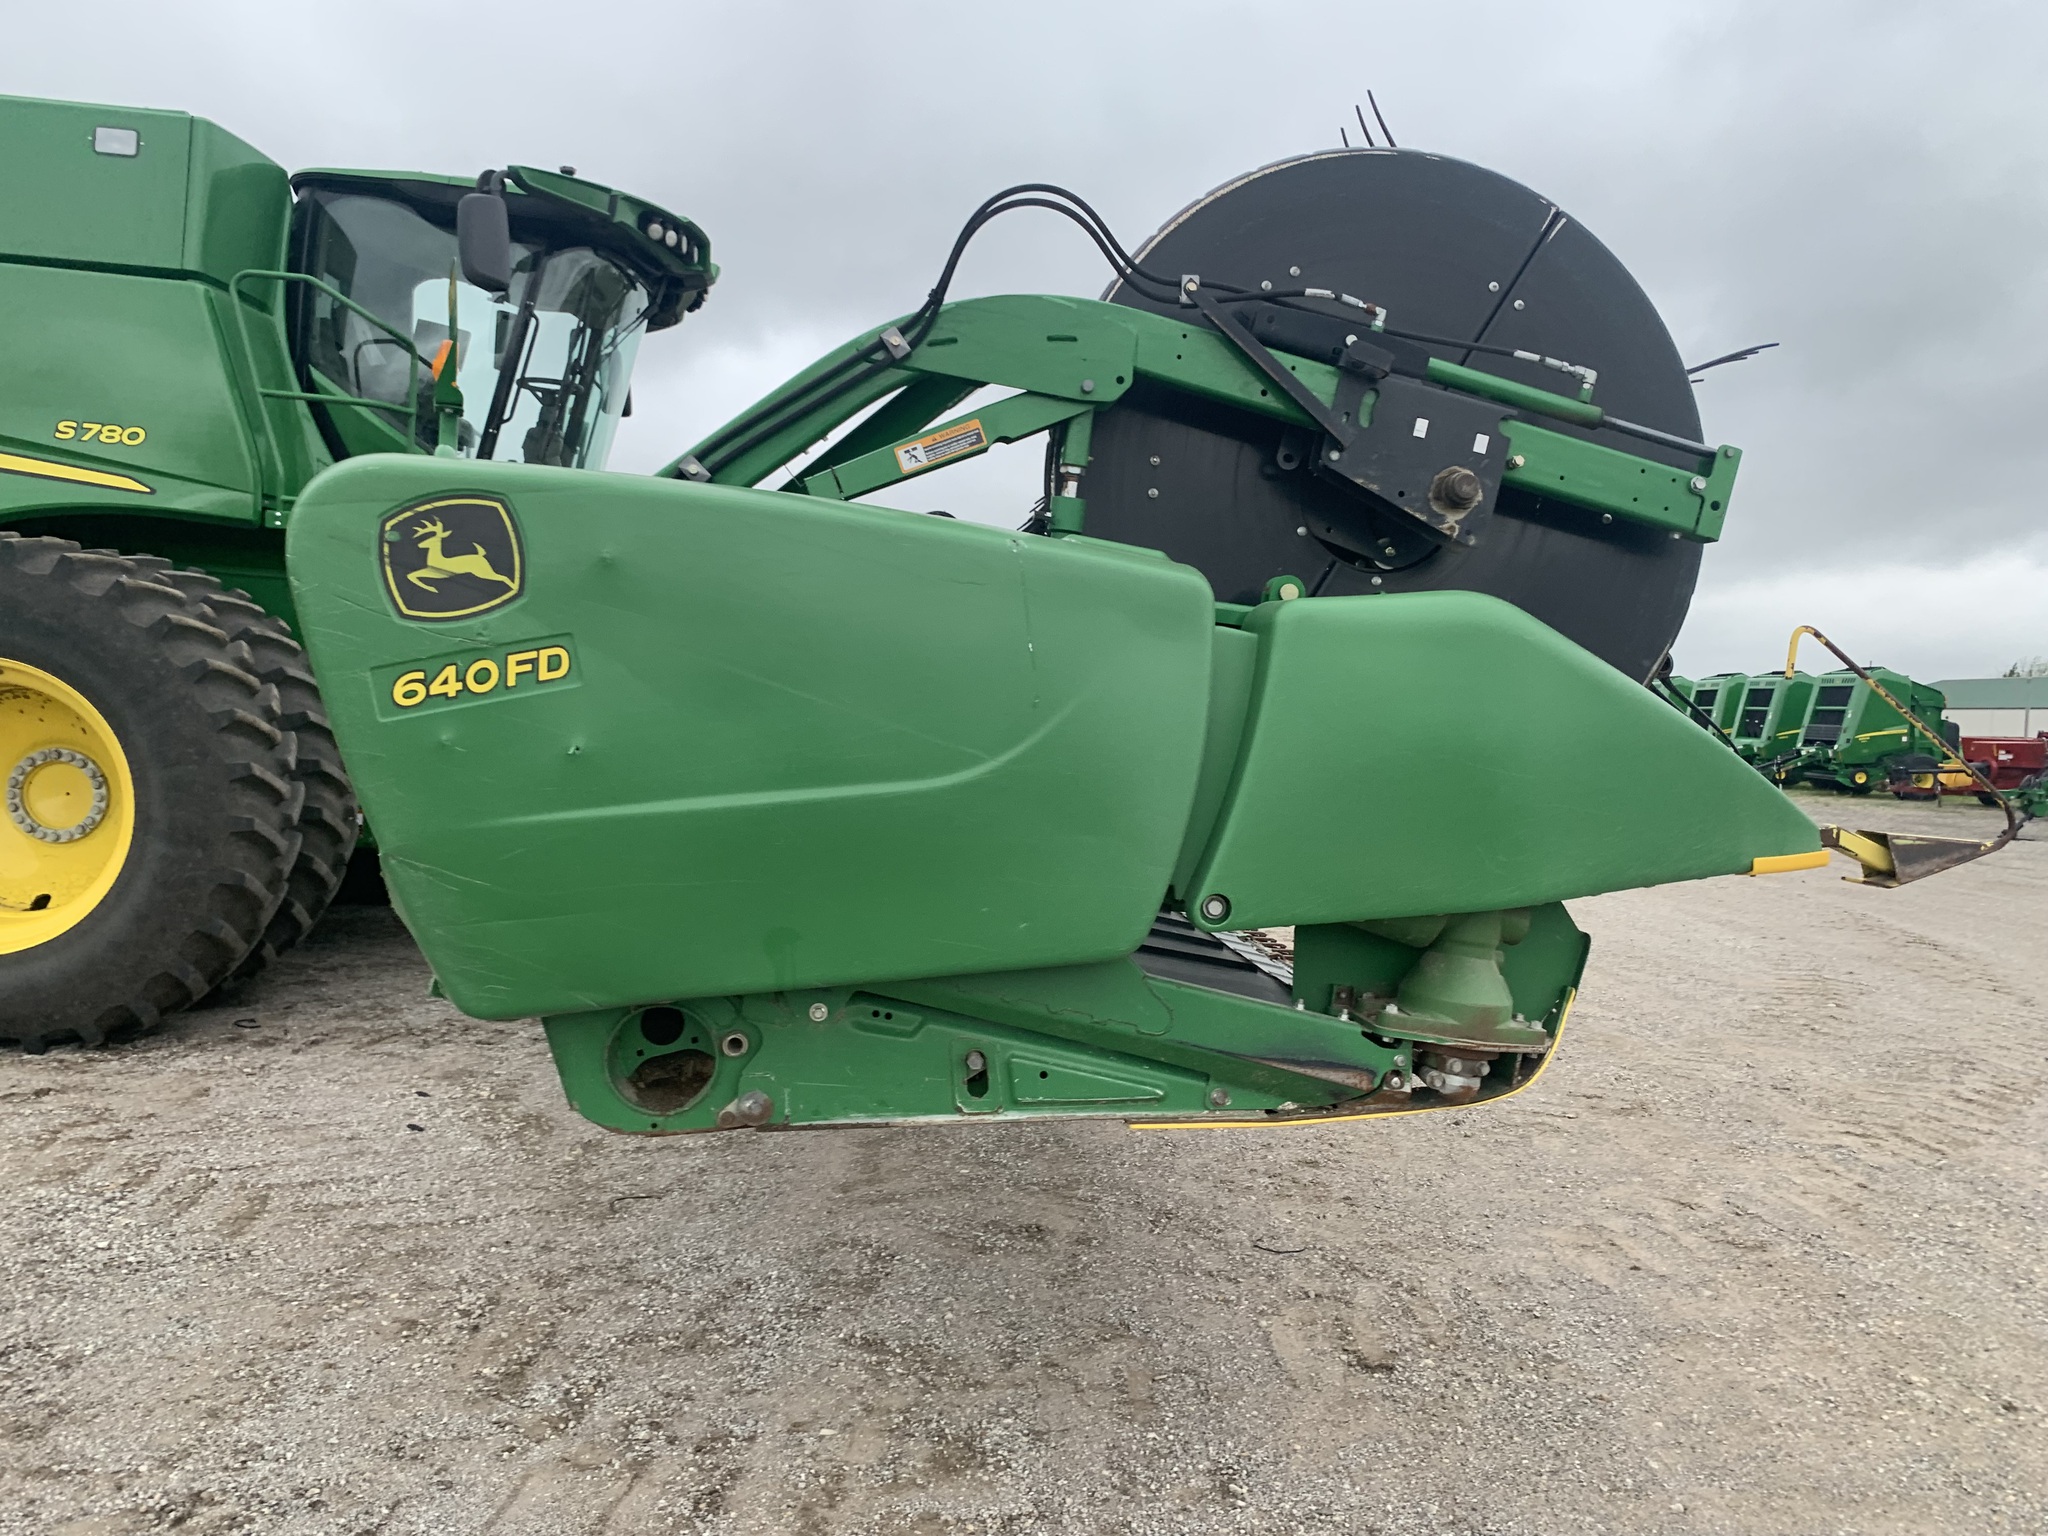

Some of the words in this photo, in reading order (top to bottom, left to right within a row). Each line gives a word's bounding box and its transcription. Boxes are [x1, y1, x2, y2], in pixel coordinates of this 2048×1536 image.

[54, 420, 146, 446] S780
[939, 425, 971, 439] WARNING
[392, 645, 571, 708] 640FD
